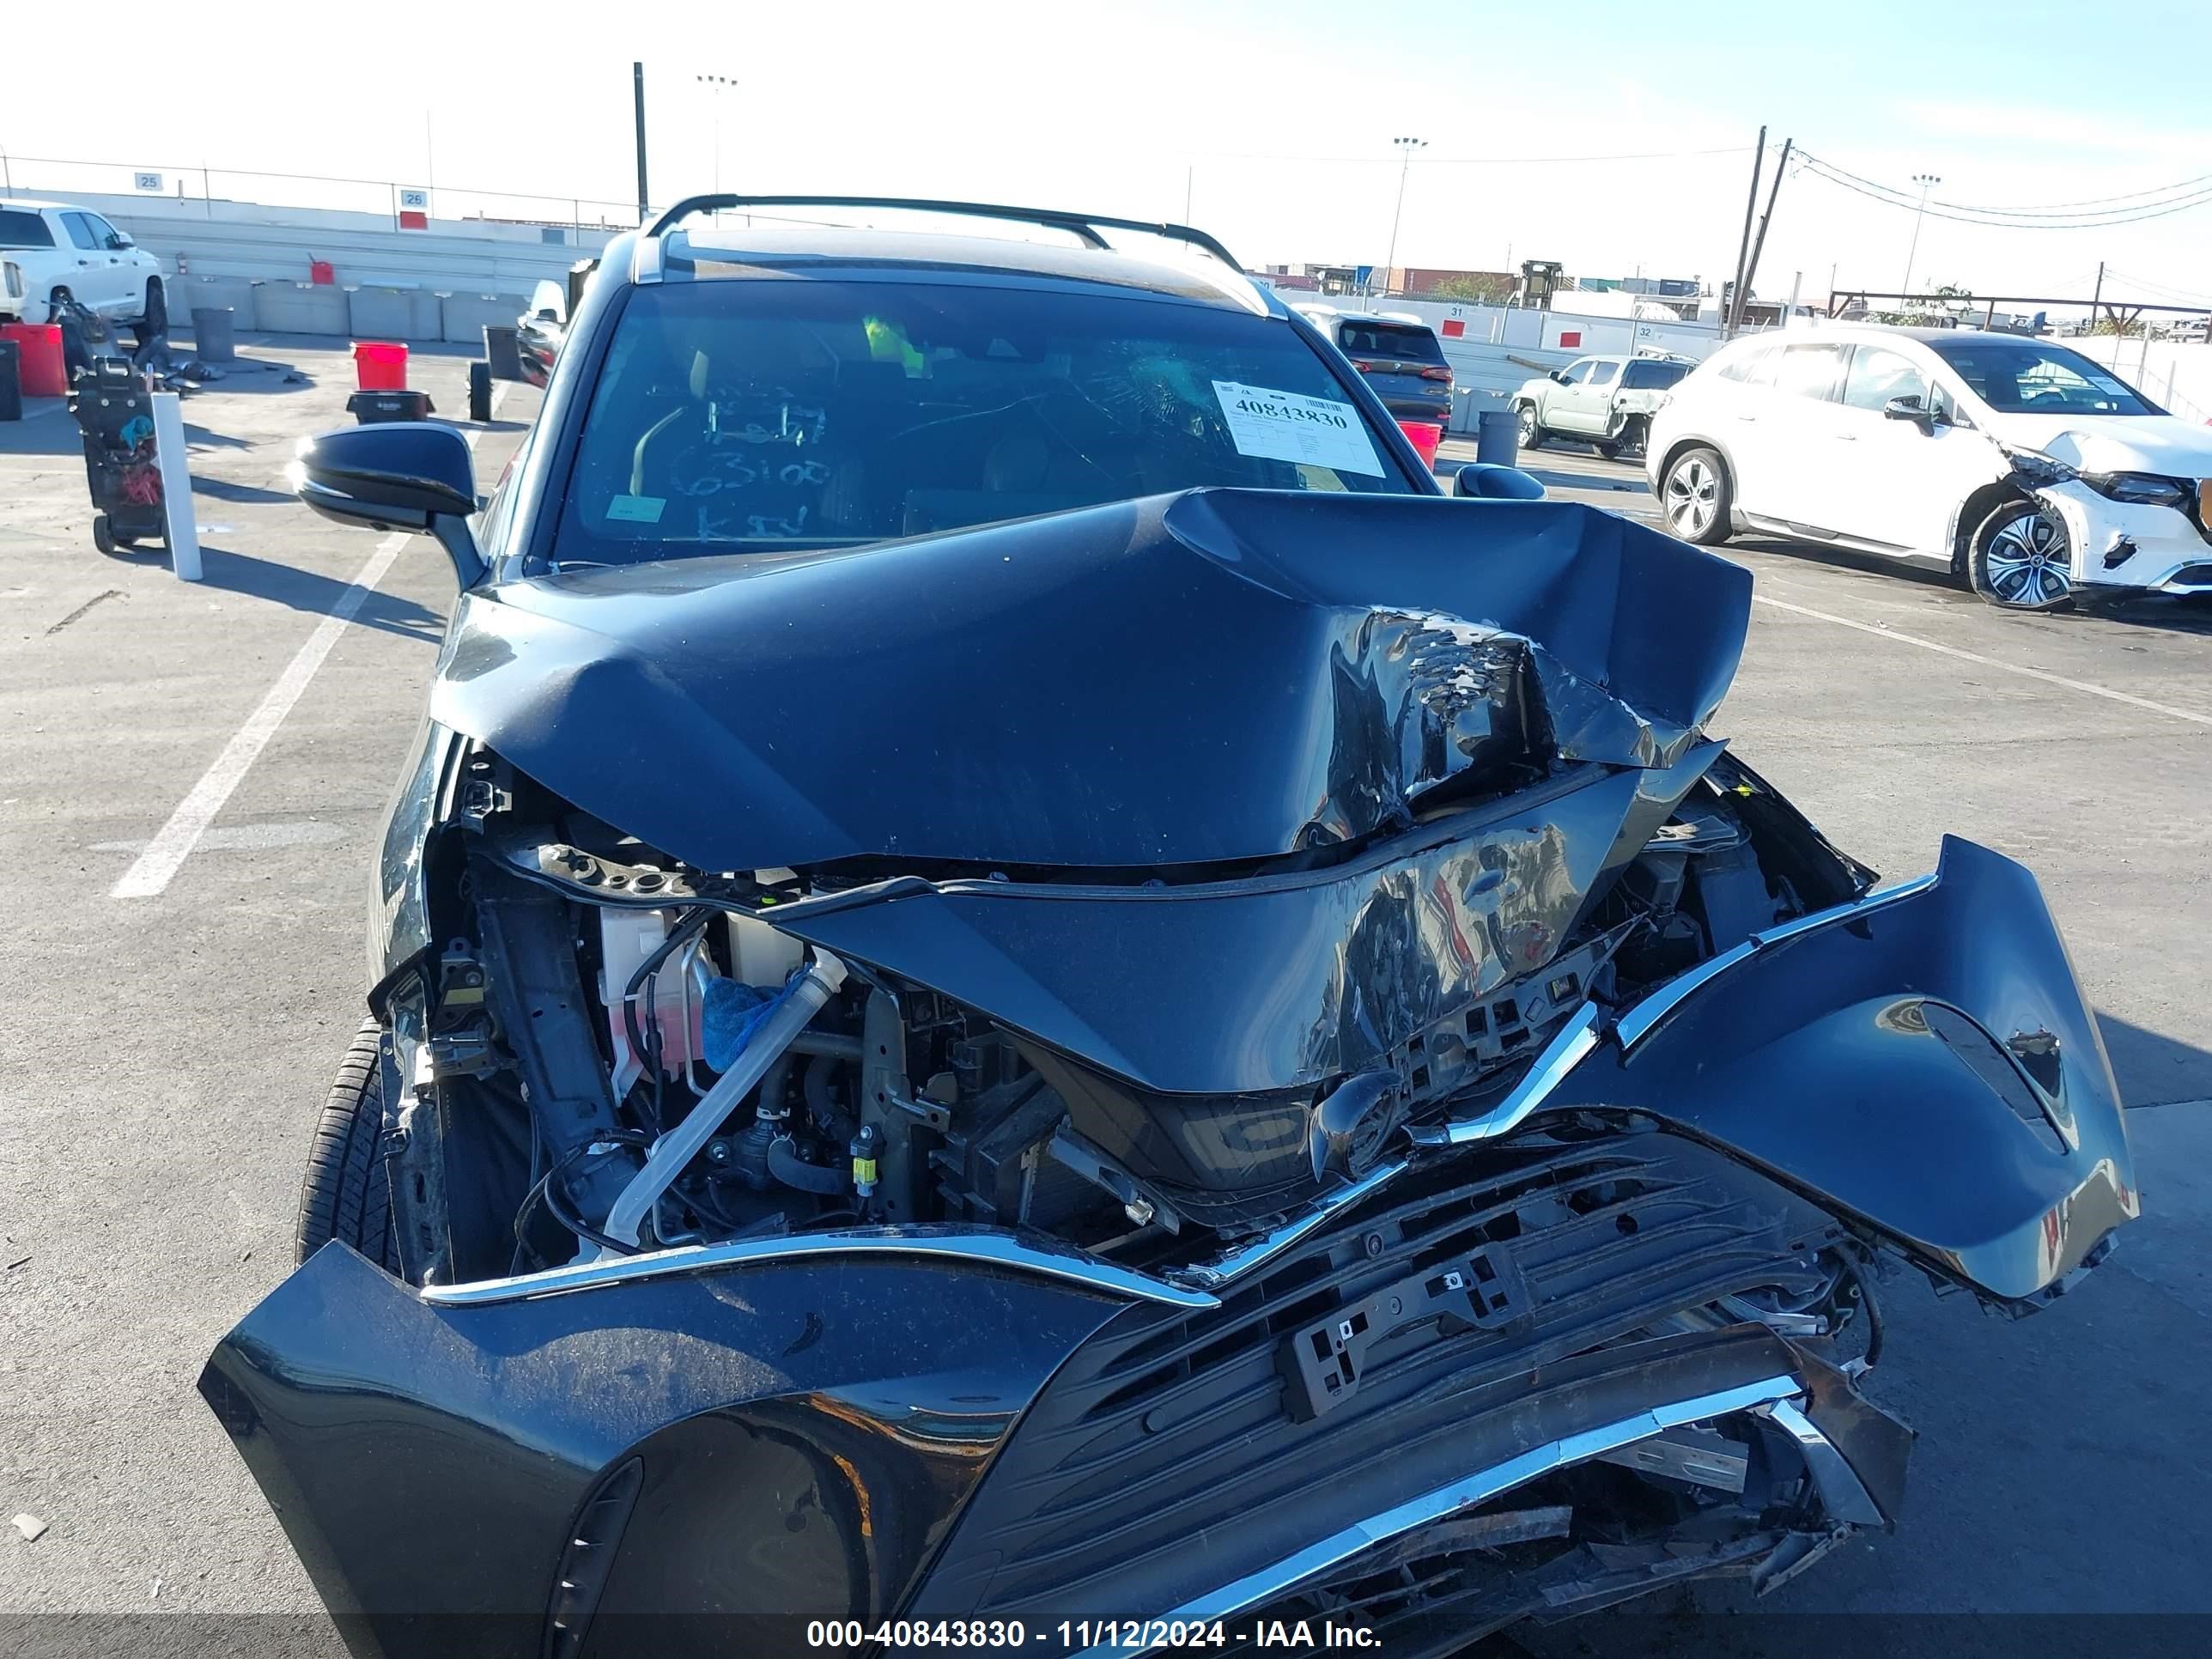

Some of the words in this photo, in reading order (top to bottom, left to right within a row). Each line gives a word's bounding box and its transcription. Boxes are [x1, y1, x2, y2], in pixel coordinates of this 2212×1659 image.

[141, 177, 157, 187] 25
[407, 194, 422, 205] 26
[1450, 307, 1462, 317] 31
[1639, 327, 1651, 337] 32
[1236, 398, 1348, 430] 40843830
